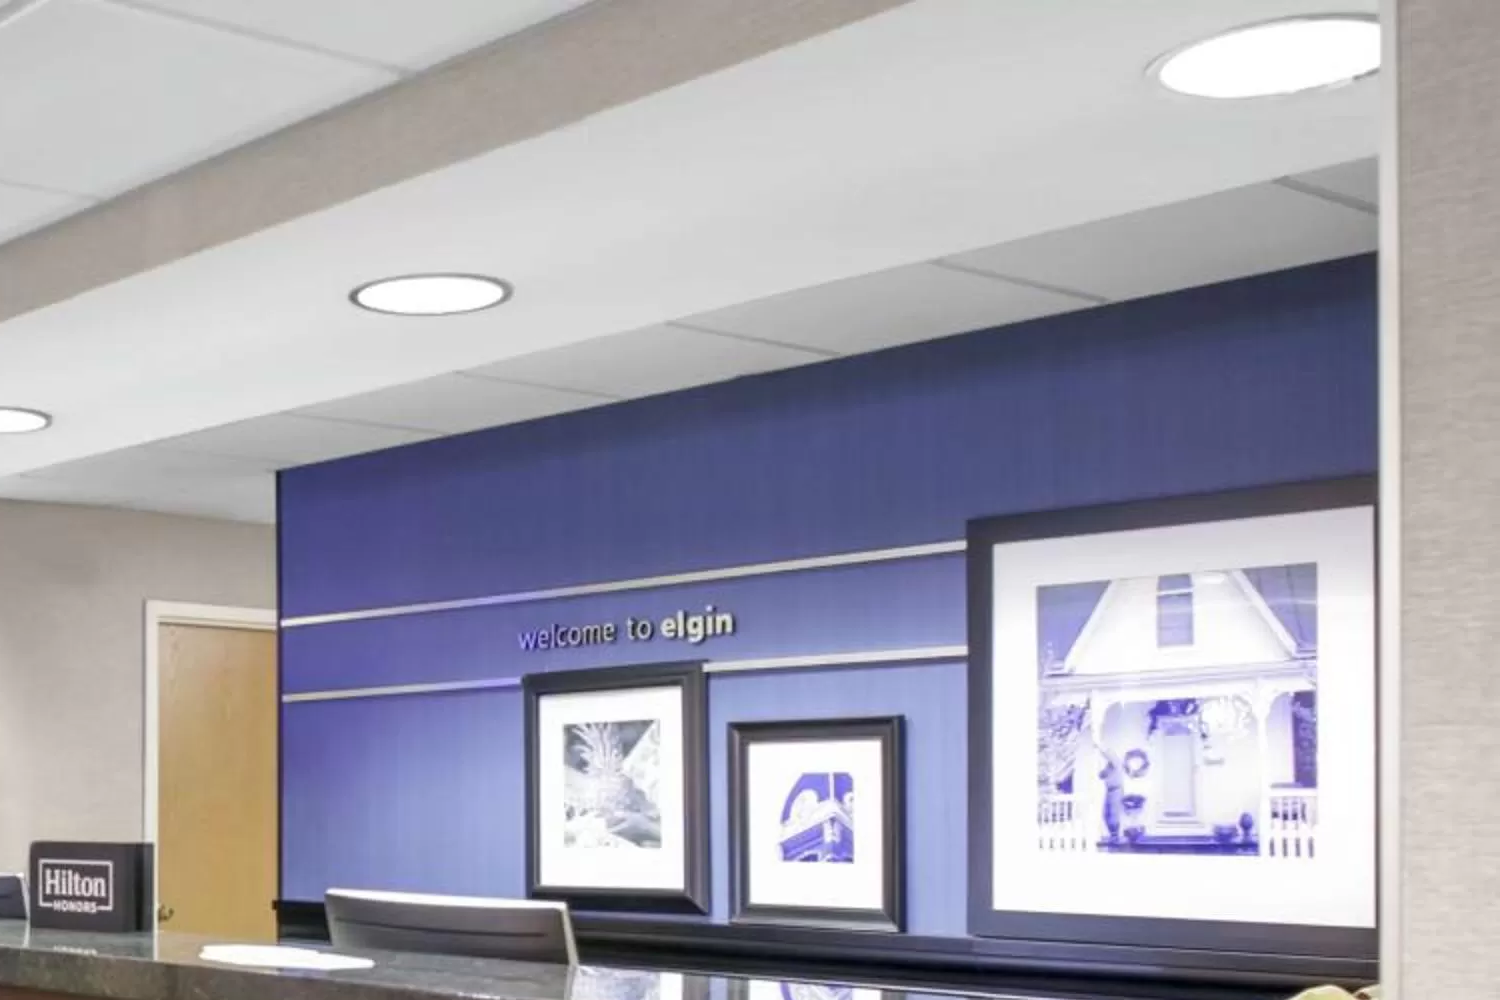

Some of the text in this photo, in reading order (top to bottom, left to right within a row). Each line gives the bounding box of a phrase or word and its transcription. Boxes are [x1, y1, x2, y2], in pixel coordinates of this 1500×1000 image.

[517, 604, 734, 651] welcome to elgin
[44, 868, 106, 897] Hilton
[52, 900, 97, 913] HONORS
